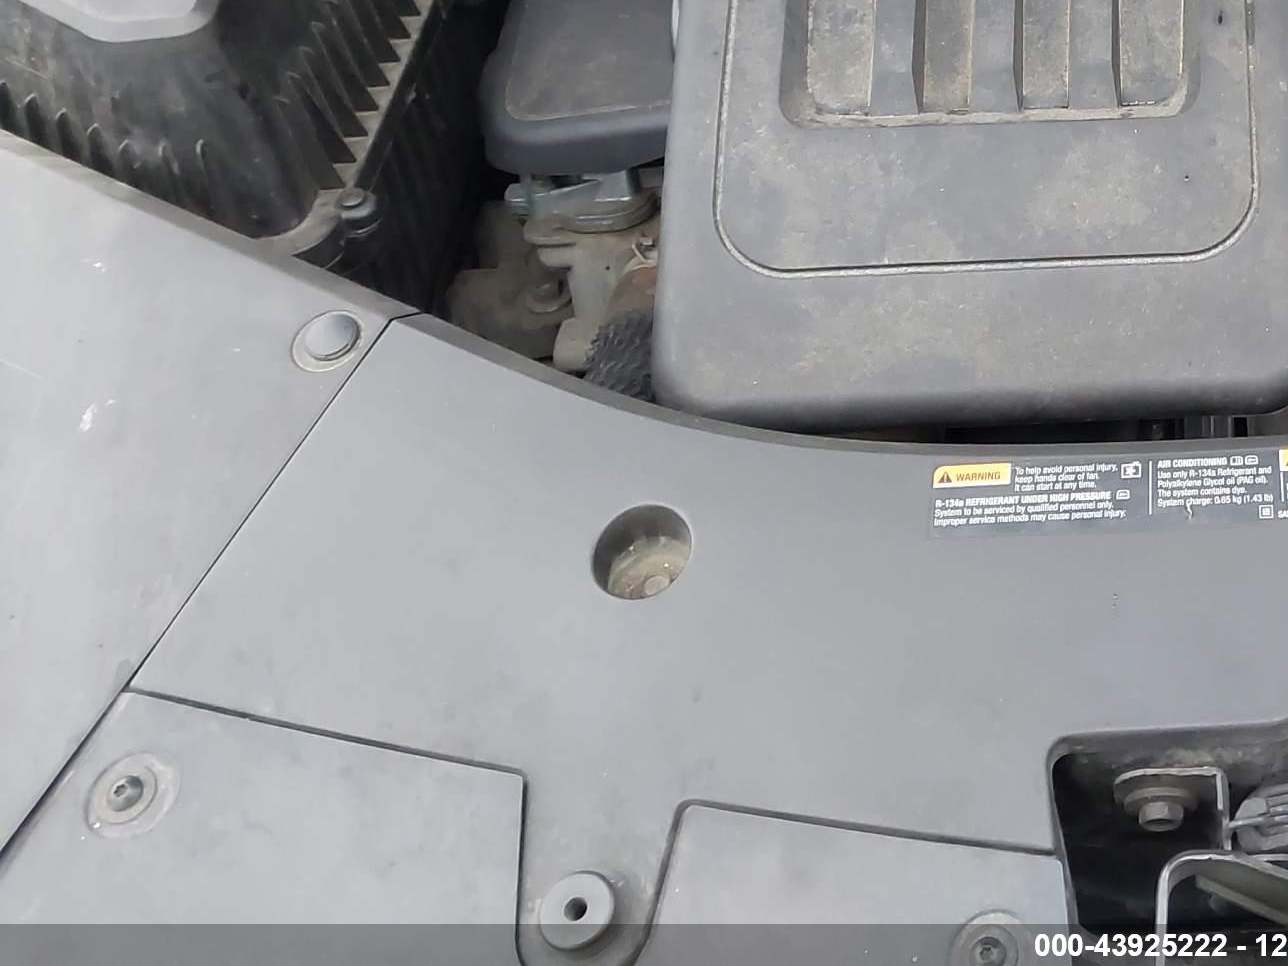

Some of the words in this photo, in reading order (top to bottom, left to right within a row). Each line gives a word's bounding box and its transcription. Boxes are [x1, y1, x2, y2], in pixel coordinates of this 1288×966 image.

[1157, 460, 1170, 468] AIR
[1172, 457, 1228, 467] CONDITIONING
[1064, 464, 1094, 474] personal
[1157, 471, 1170, 479] Use
[1172, 470, 1188, 479] only
[1217, 467, 1256, 477] Refrigerant
[1258, 465, 1272, 473] and
[956, 471, 1000, 481] WARNING
[1015, 475, 1032, 484] keep
[1058, 473, 1076, 481] clear
[1157, 489, 1170, 497] The
[1172, 488, 1198, 497] system
[1200, 486, 1230, 495] contains
[966, 495, 1019, 505] REFRIGERANT
[1020, 494, 1048, 503] UNDER
[1049, 493, 1068, 502] HIGH
[1070, 491, 1111, 500] PRESSURE
[1157, 498, 1184, 507] System
[934, 508, 962, 518] System
[984, 505, 1015, 514] serviced
[1016, 505, 1025, 513] by
[1026, 504, 1058, 513] qualified
[1060, 502, 1096, 511] personnel
[996, 514, 1029, 522] methods
[1030, 514, 1046, 522] may
[1048, 512, 1070, 520] cause
[1071, 511, 1102, 520] personal
